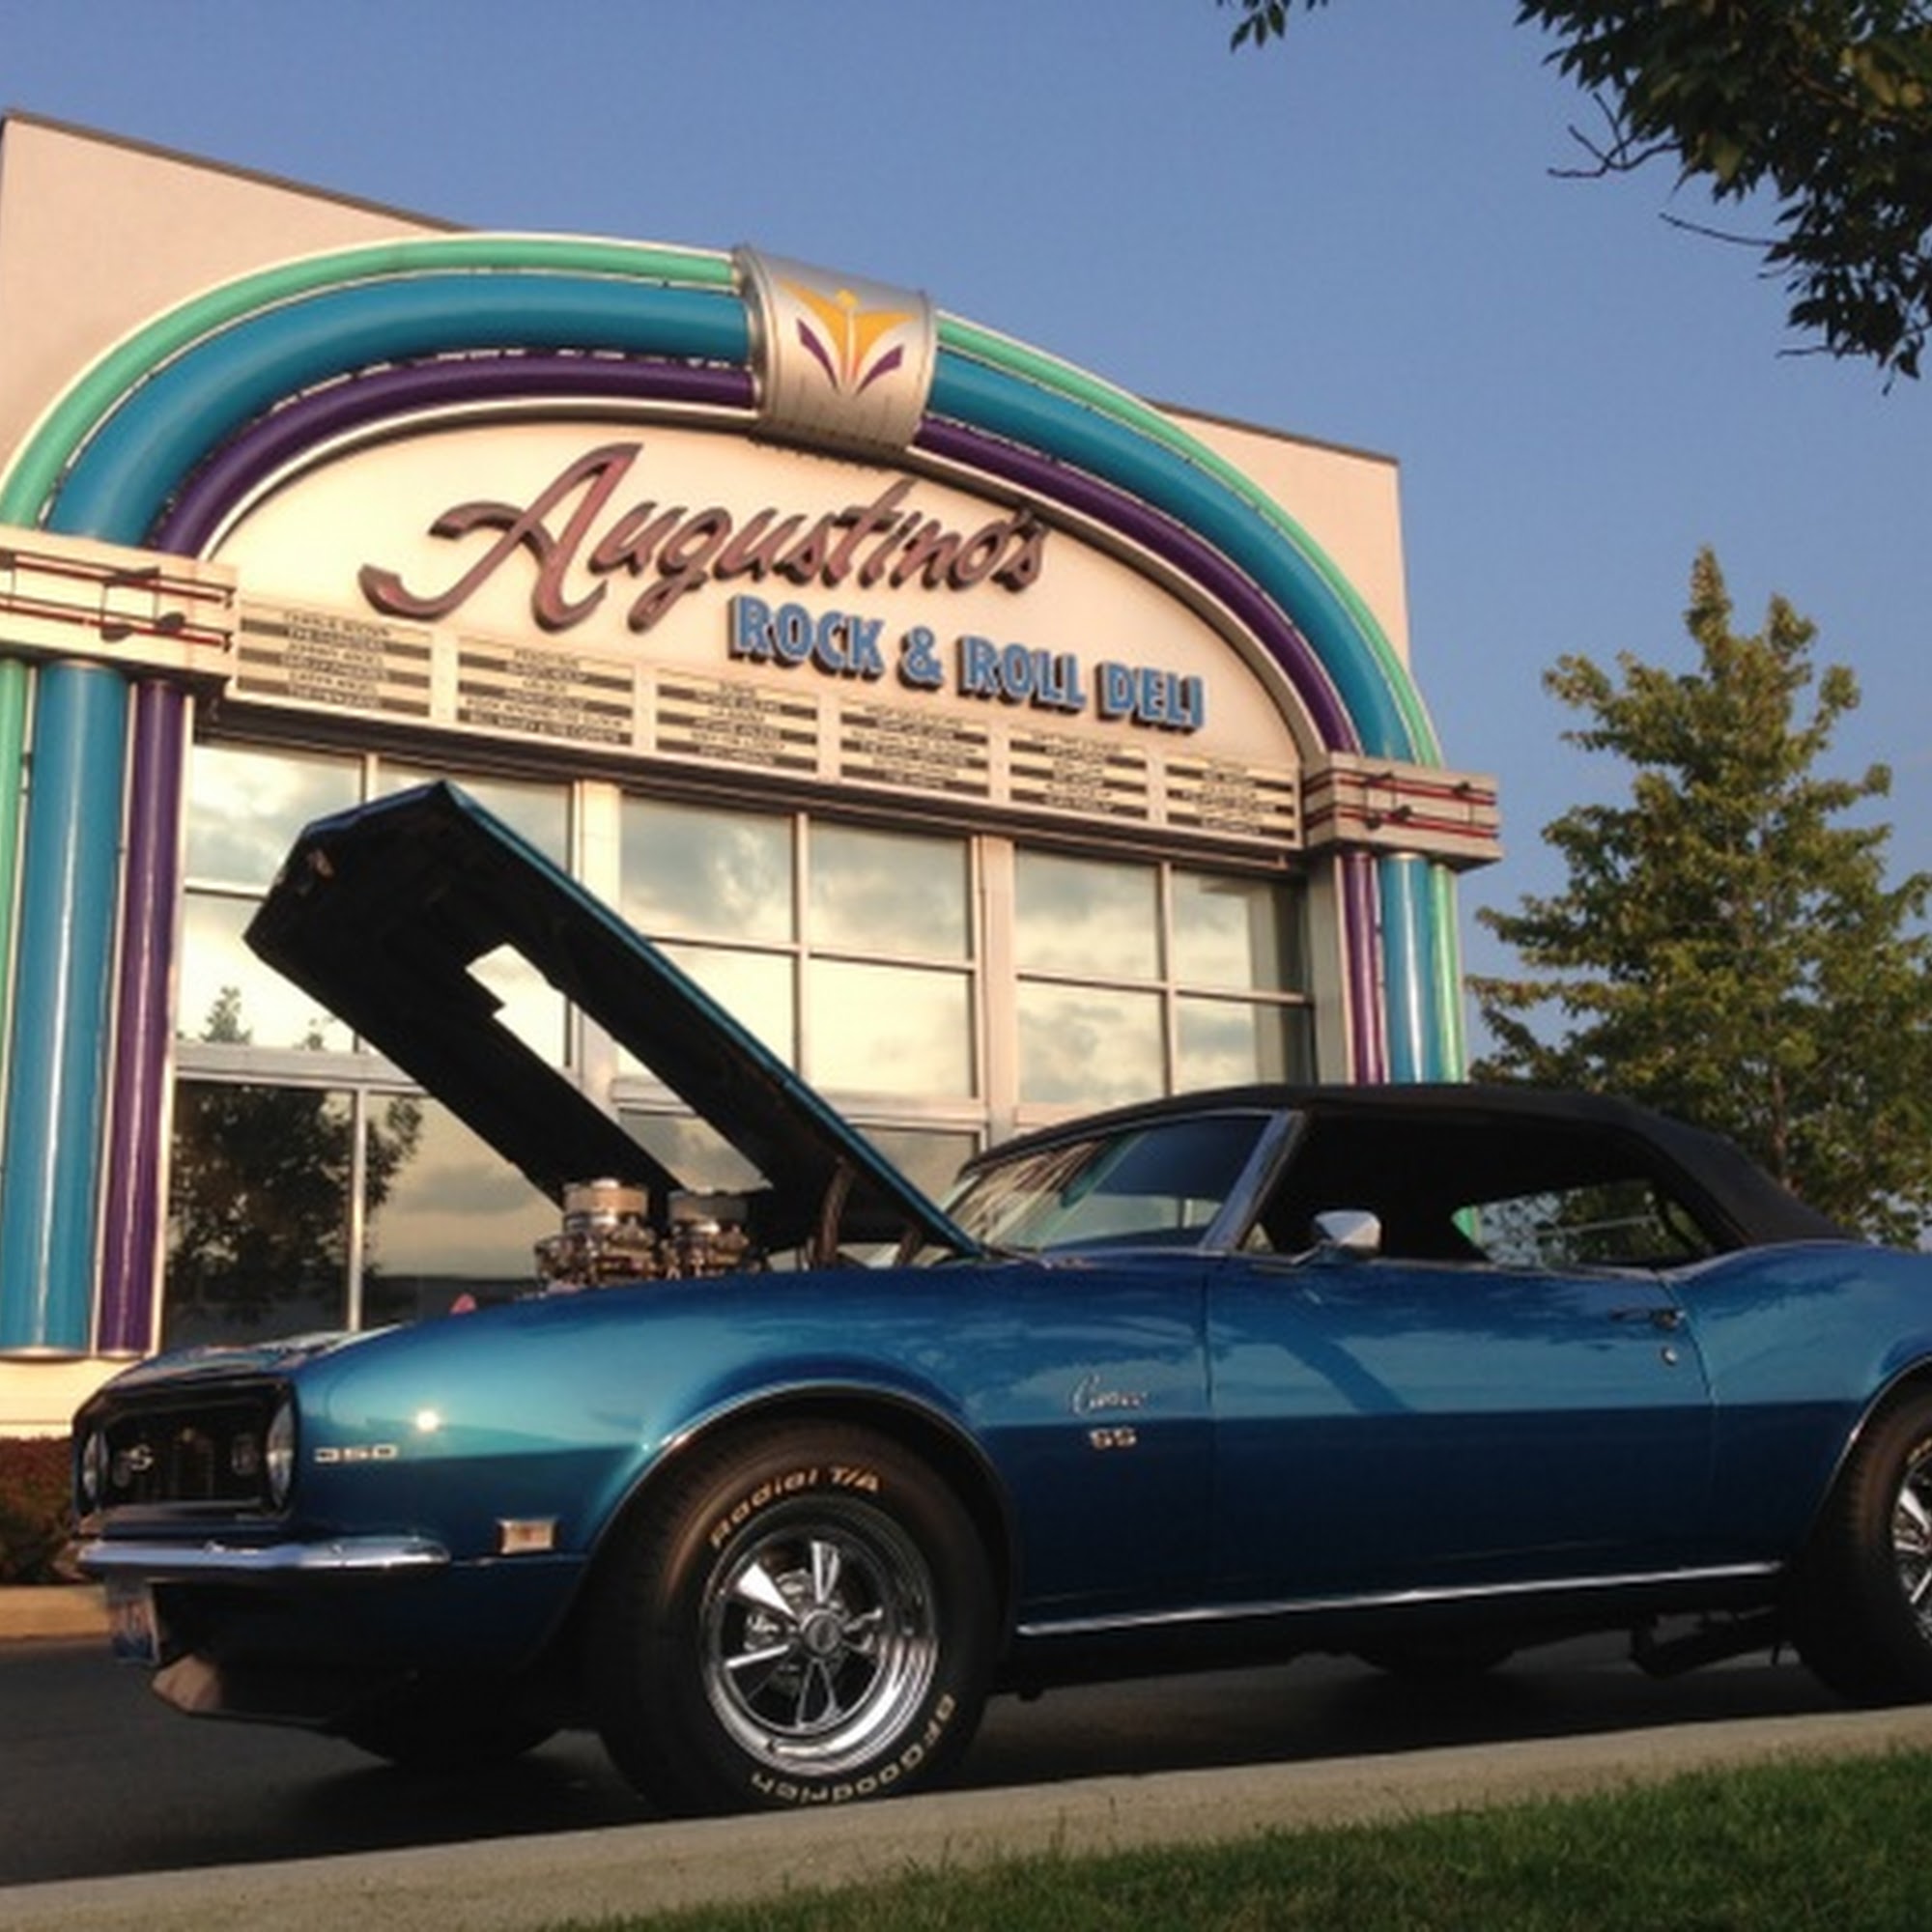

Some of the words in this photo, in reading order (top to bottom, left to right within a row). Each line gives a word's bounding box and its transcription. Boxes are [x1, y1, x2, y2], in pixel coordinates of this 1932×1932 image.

[357, 441, 1048, 634] Augustino's
[727, 593, 886, 683] ROCK
[899, 626, 944, 690] &
[956, 635, 1087, 713] ROLL
[1095, 661, 1205, 733] DELI
